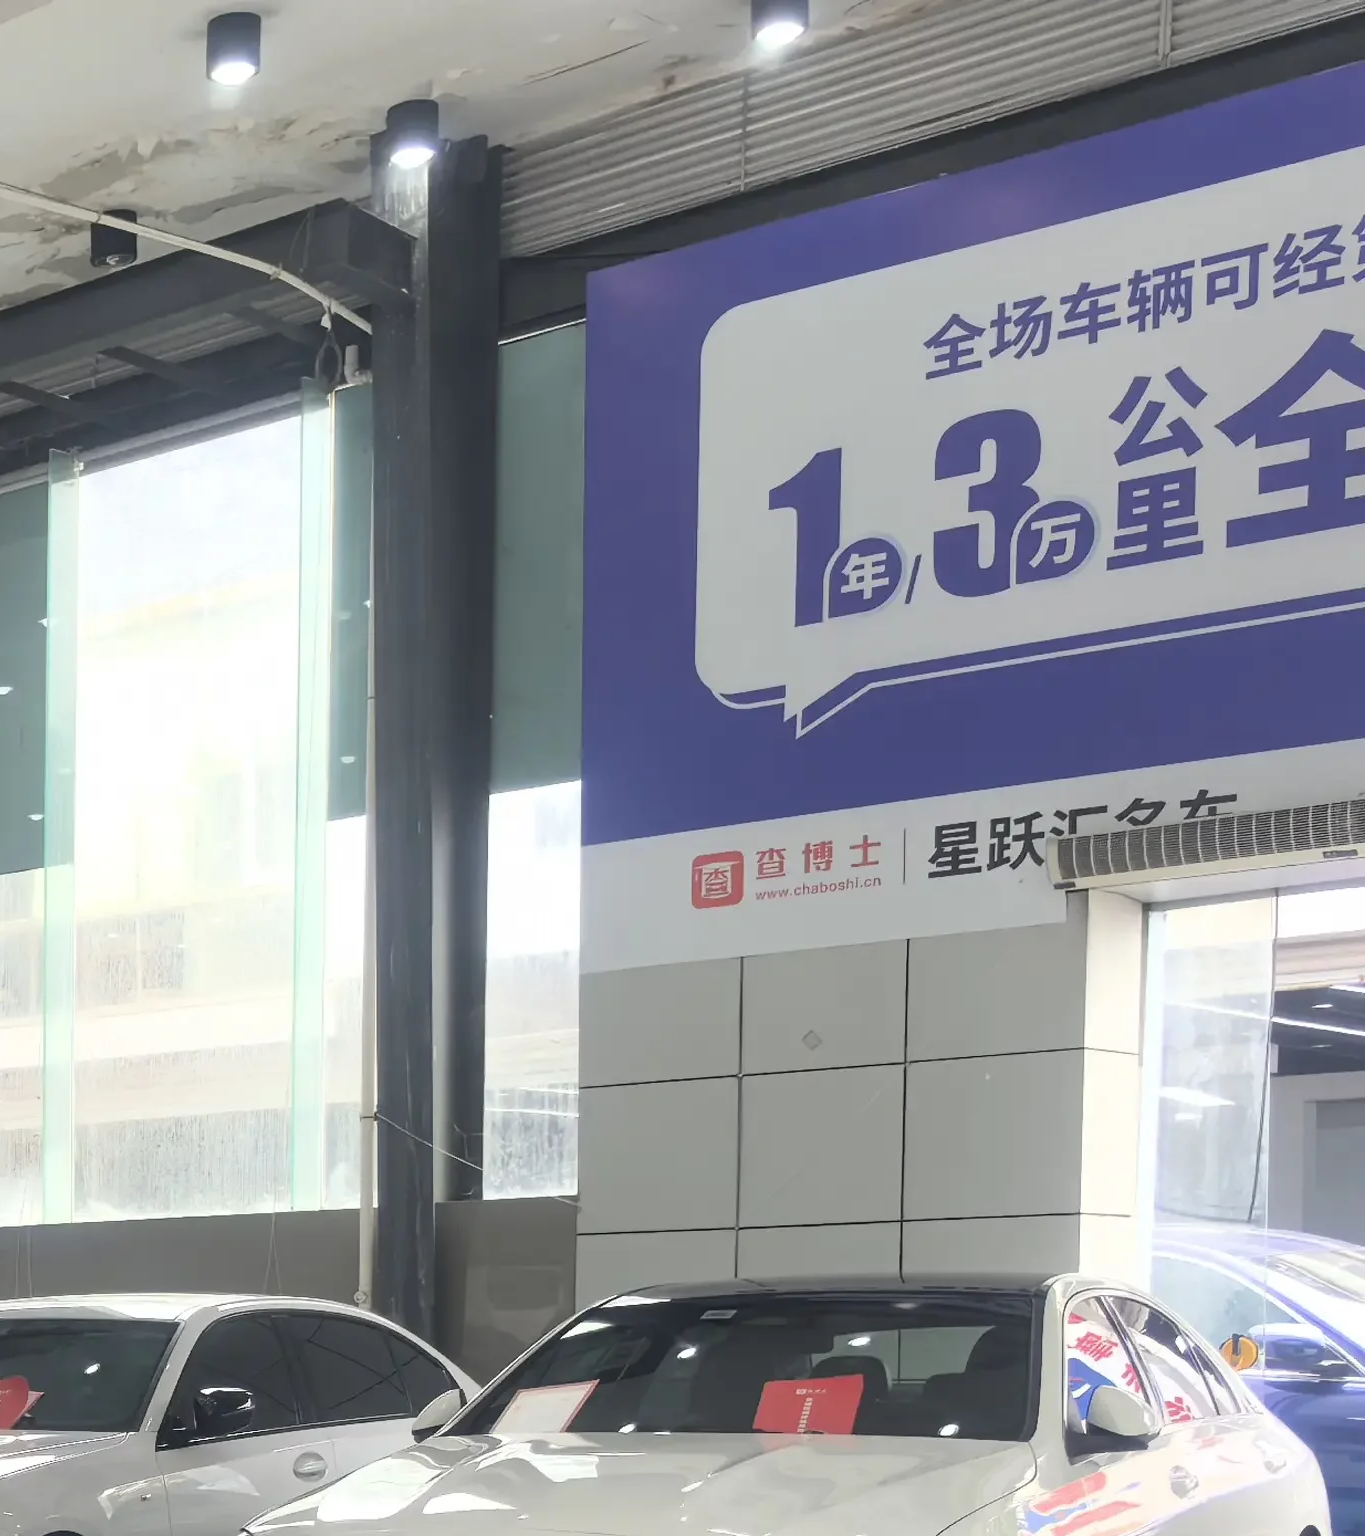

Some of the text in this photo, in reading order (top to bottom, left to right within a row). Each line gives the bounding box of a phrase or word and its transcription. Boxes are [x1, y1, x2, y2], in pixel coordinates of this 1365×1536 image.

[923, 213, 1365, 380] 全场车辆可经
[756, 834, 882, 880] 查博士
[755, 876, 882, 901] www.chaboshi.cn
